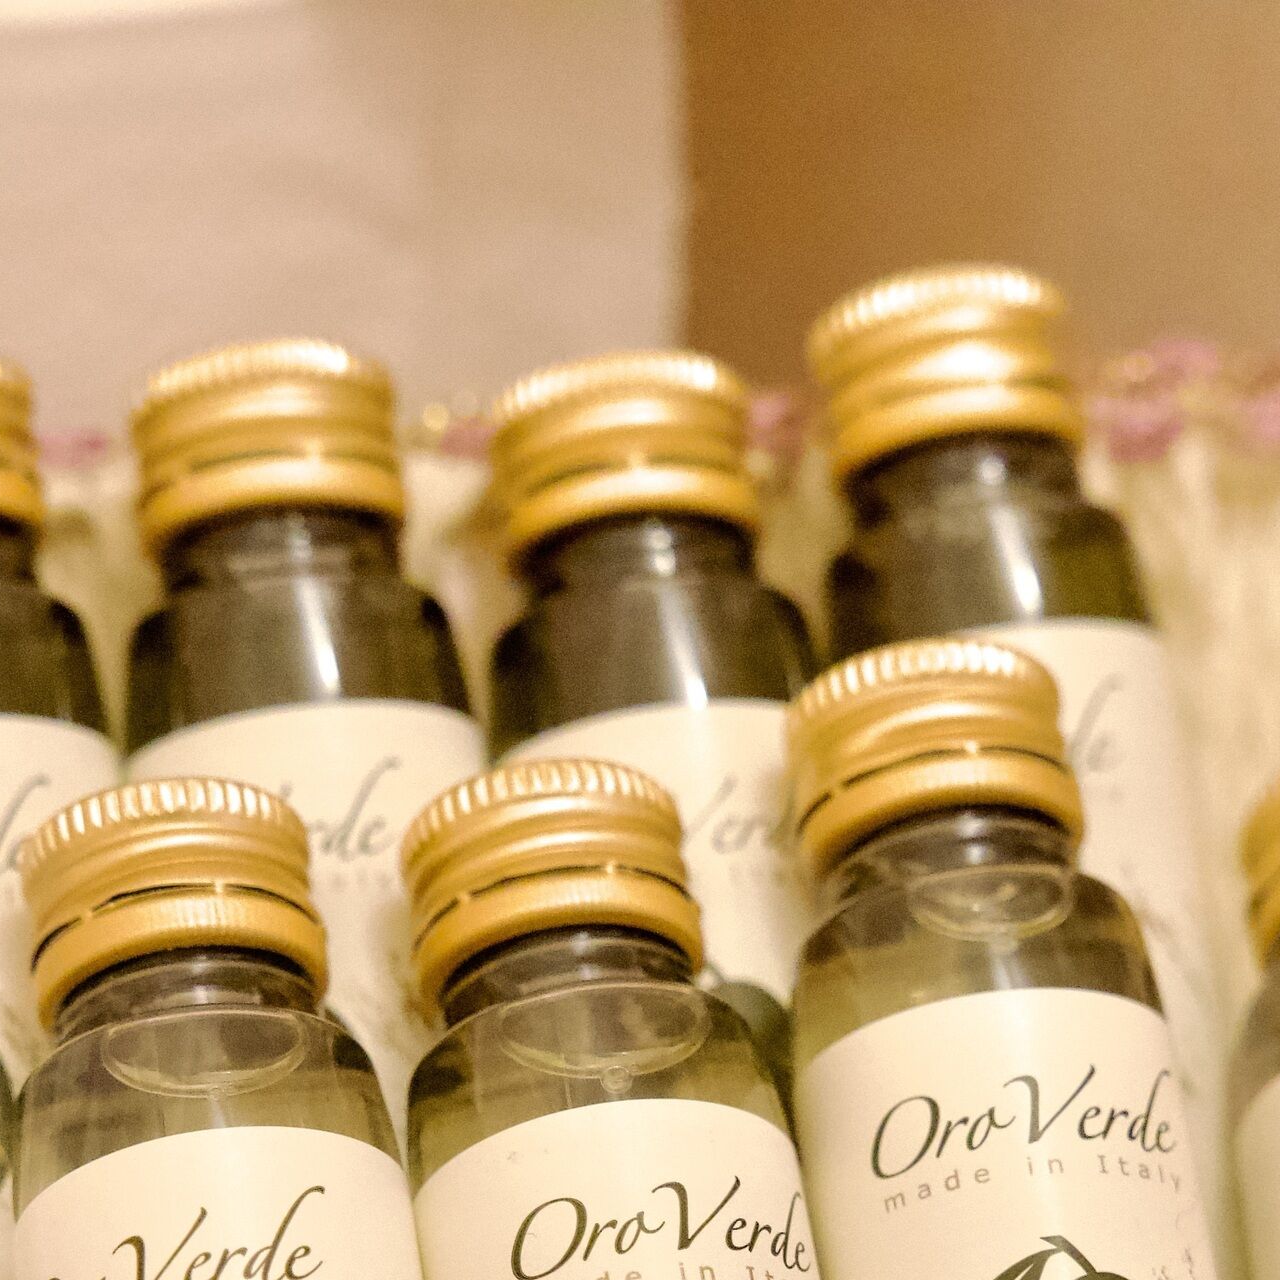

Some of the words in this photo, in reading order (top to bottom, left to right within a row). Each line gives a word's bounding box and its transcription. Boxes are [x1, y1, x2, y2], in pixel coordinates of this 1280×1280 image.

[884, 1167, 990, 1213] made
[1026, 1156, 1064, 1176] in
[1097, 1154, 1182, 1192] Italy
